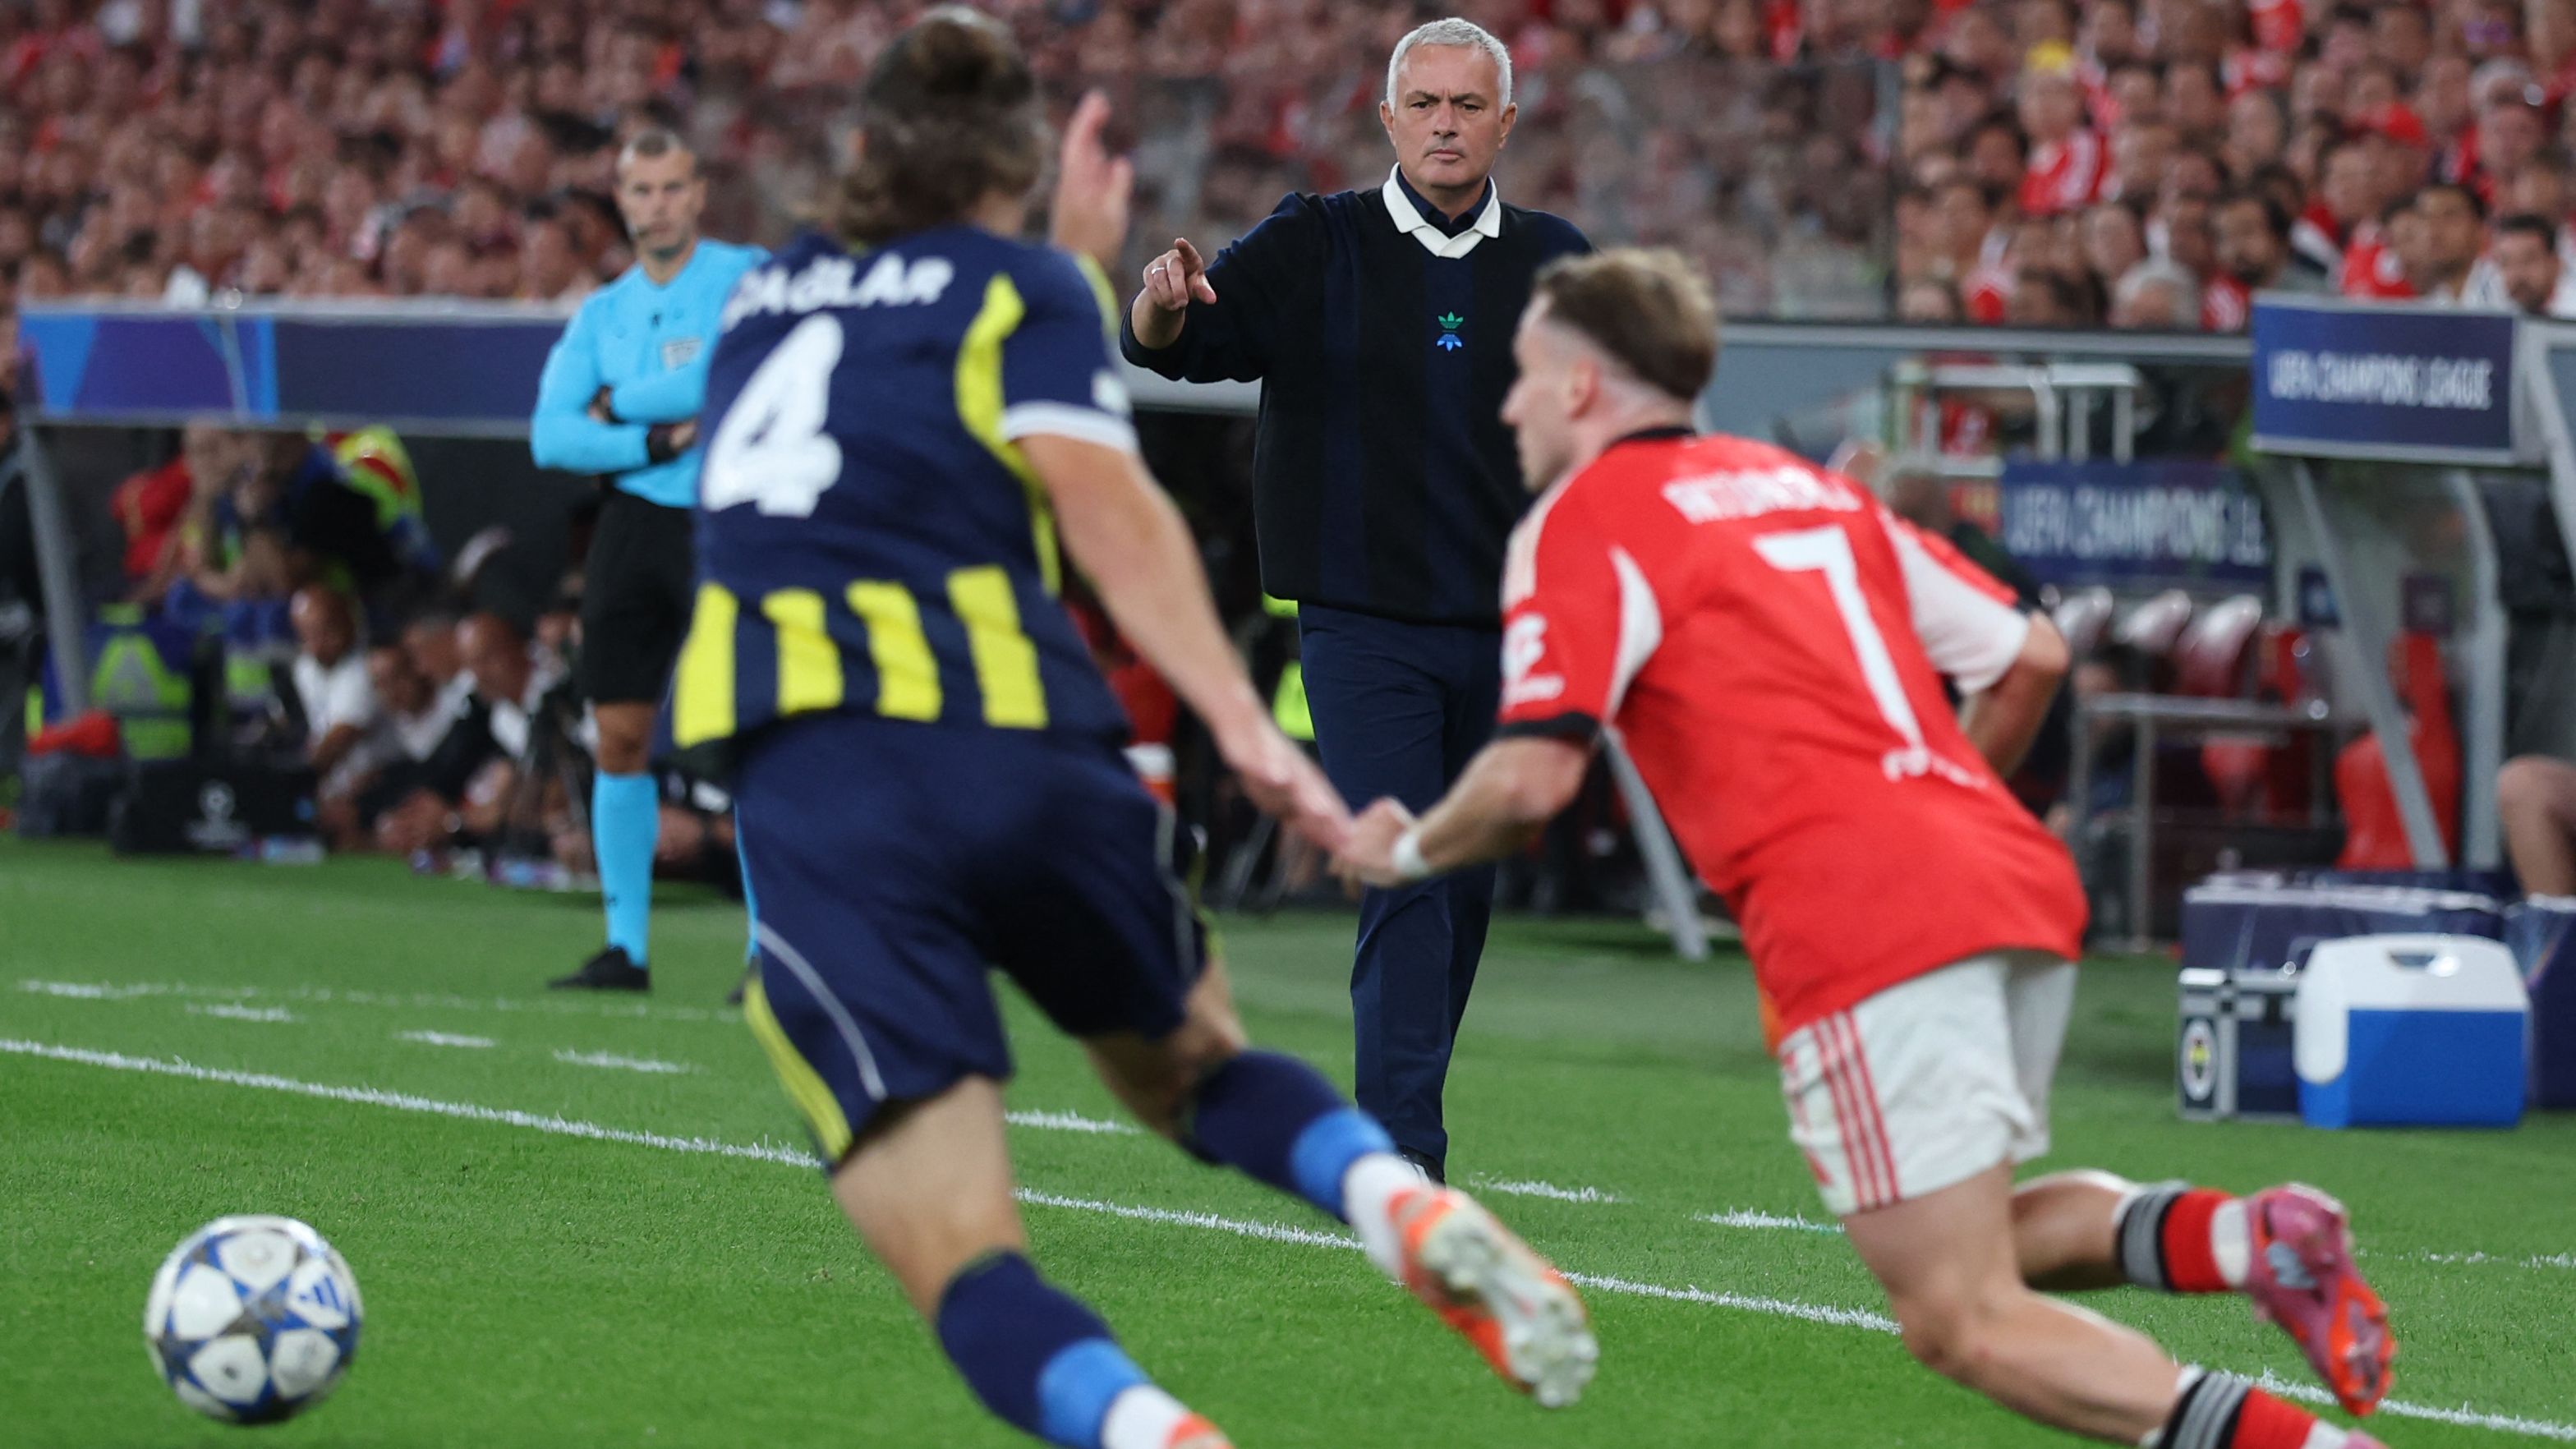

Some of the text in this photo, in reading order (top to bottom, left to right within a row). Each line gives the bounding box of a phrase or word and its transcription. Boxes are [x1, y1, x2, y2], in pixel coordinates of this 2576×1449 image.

[702, 312, 844, 518] 4
[2316, 350, 2422, 407] CHAMPIONS
[2423, 355, 2493, 411] LEAGUE
[1751, 524, 1925, 749] 7
